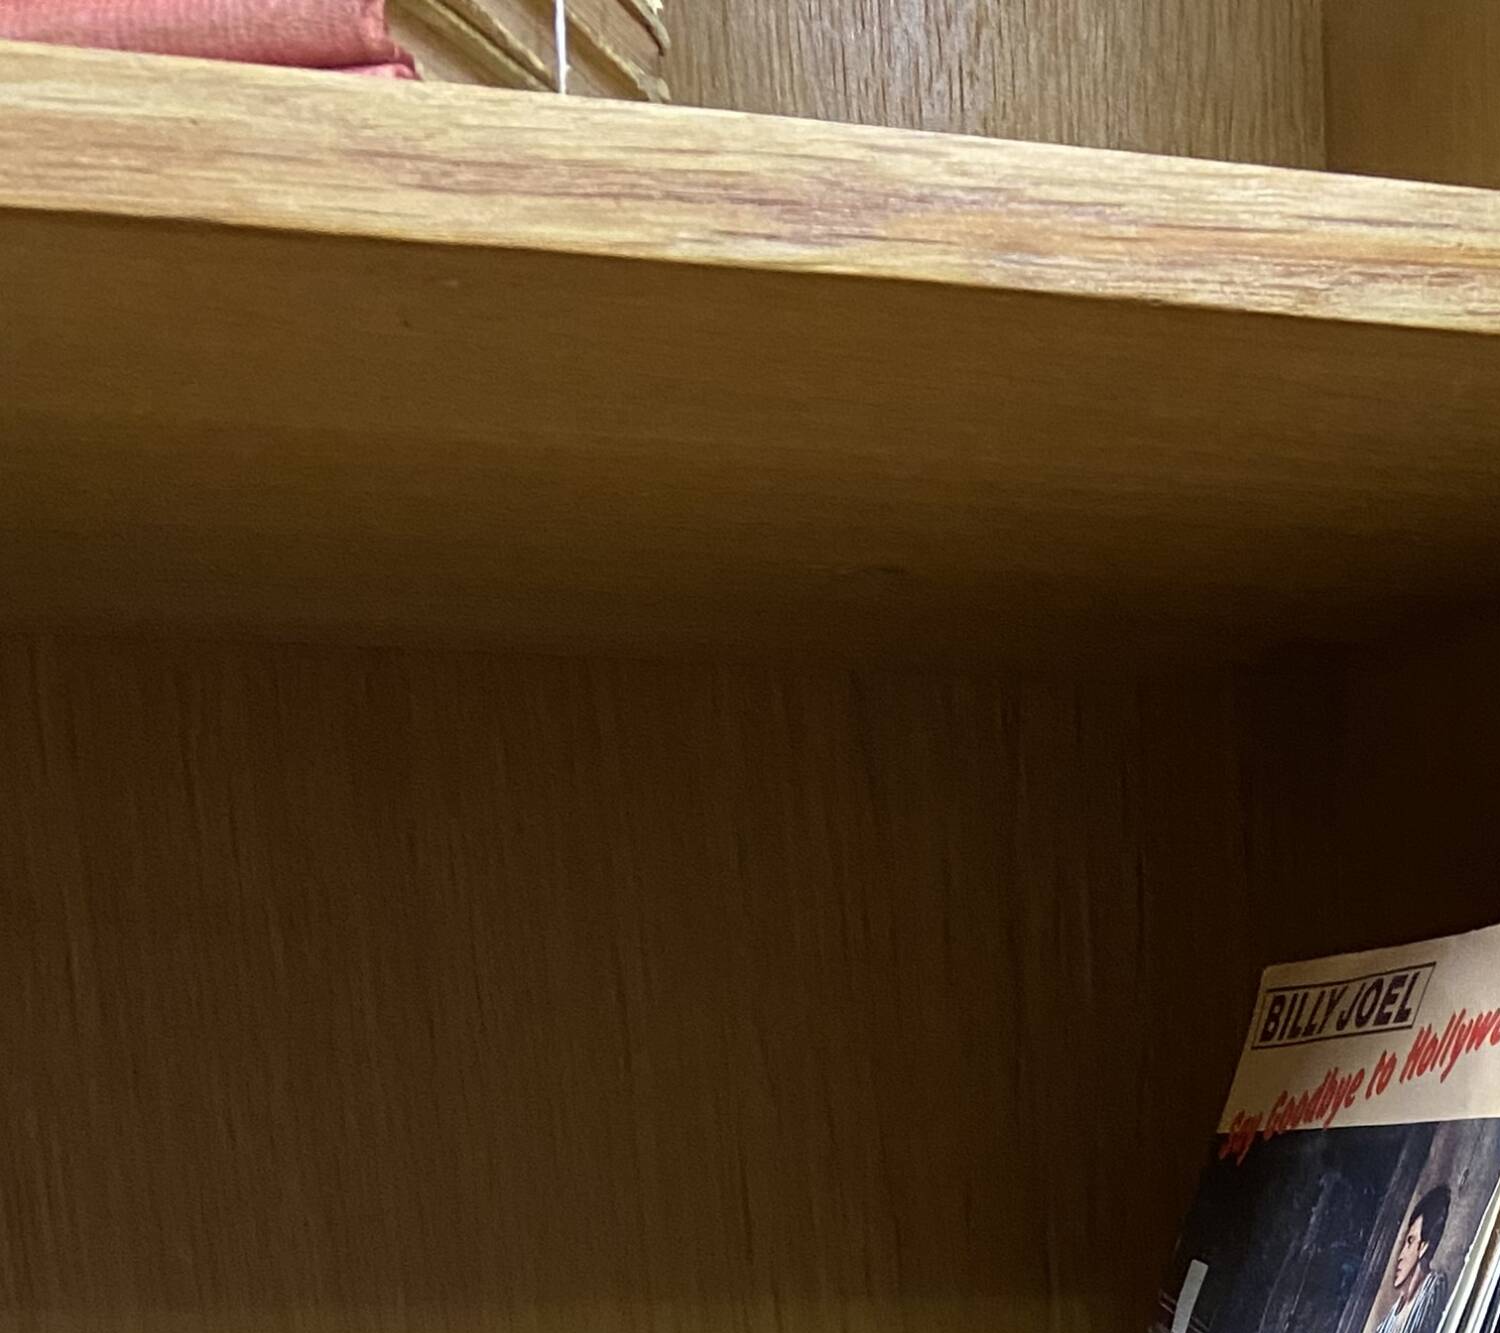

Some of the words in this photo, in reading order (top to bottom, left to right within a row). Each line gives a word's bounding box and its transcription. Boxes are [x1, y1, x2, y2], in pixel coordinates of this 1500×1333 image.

[1259, 985, 1344, 1042] BILLY
[1340, 972, 1420, 1027] JOEL
[1218, 1110, 1264, 1165] Say
[1264, 1066, 1365, 1142] Goodbye
[1365, 1050, 1396, 1099] to
